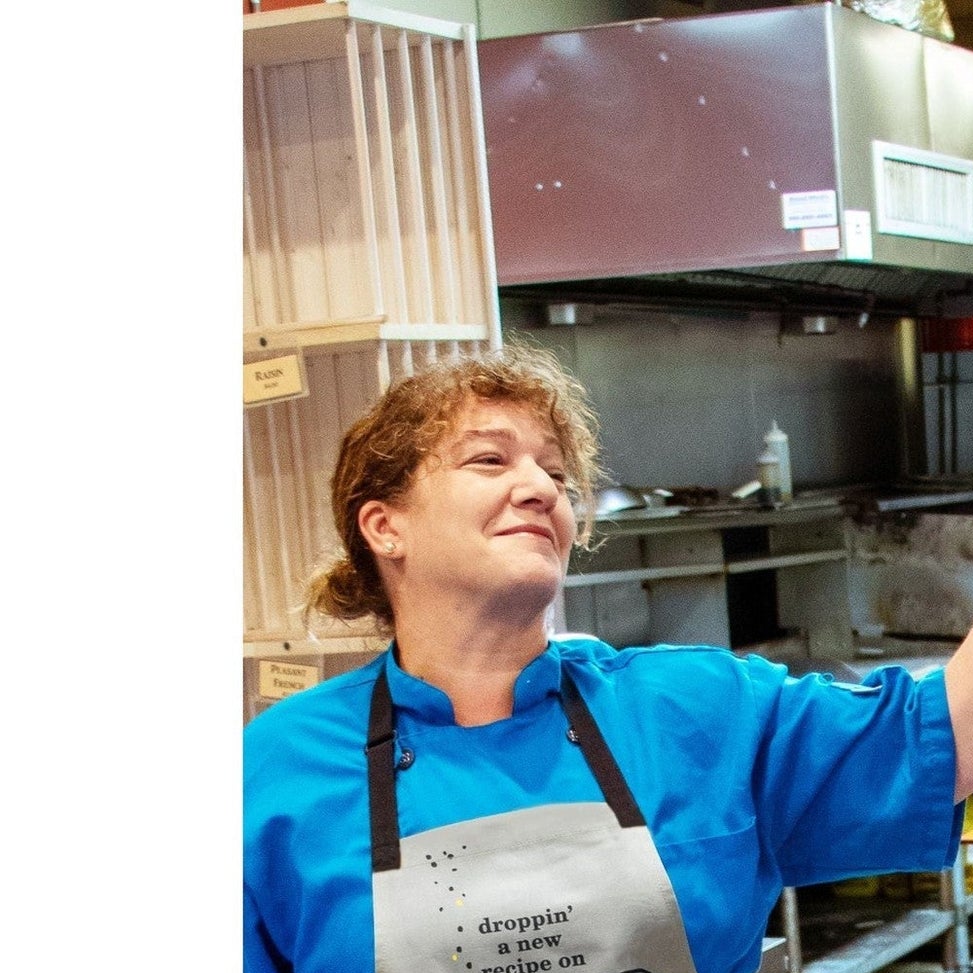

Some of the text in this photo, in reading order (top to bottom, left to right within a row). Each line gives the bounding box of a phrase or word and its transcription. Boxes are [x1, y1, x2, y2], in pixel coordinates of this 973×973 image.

[498, 934, 562, 954] a new
[558, 954, 586, 968] on
